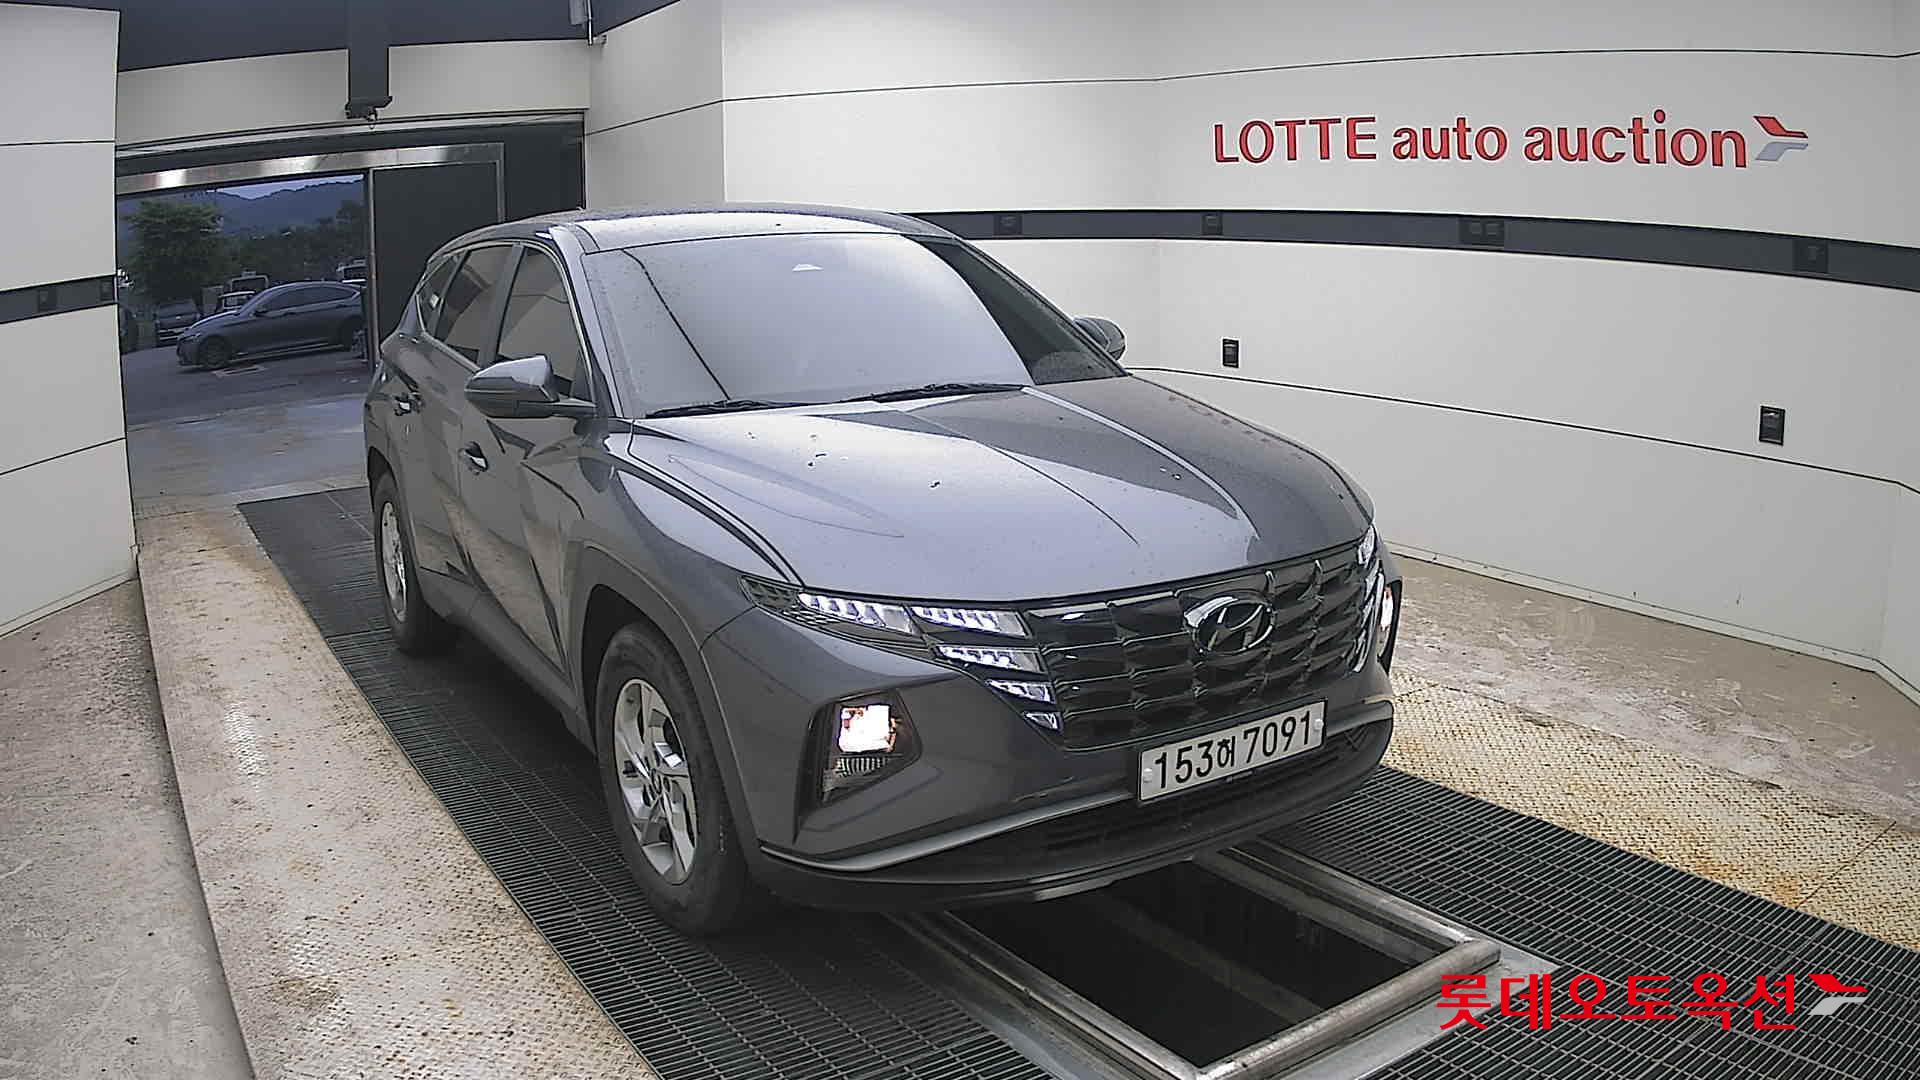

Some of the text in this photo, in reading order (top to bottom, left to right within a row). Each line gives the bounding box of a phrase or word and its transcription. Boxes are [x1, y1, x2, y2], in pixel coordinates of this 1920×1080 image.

[1213, 109, 1748, 168] LOTTE auto auction
[1154, 710, 1311, 789] 153허 7091
